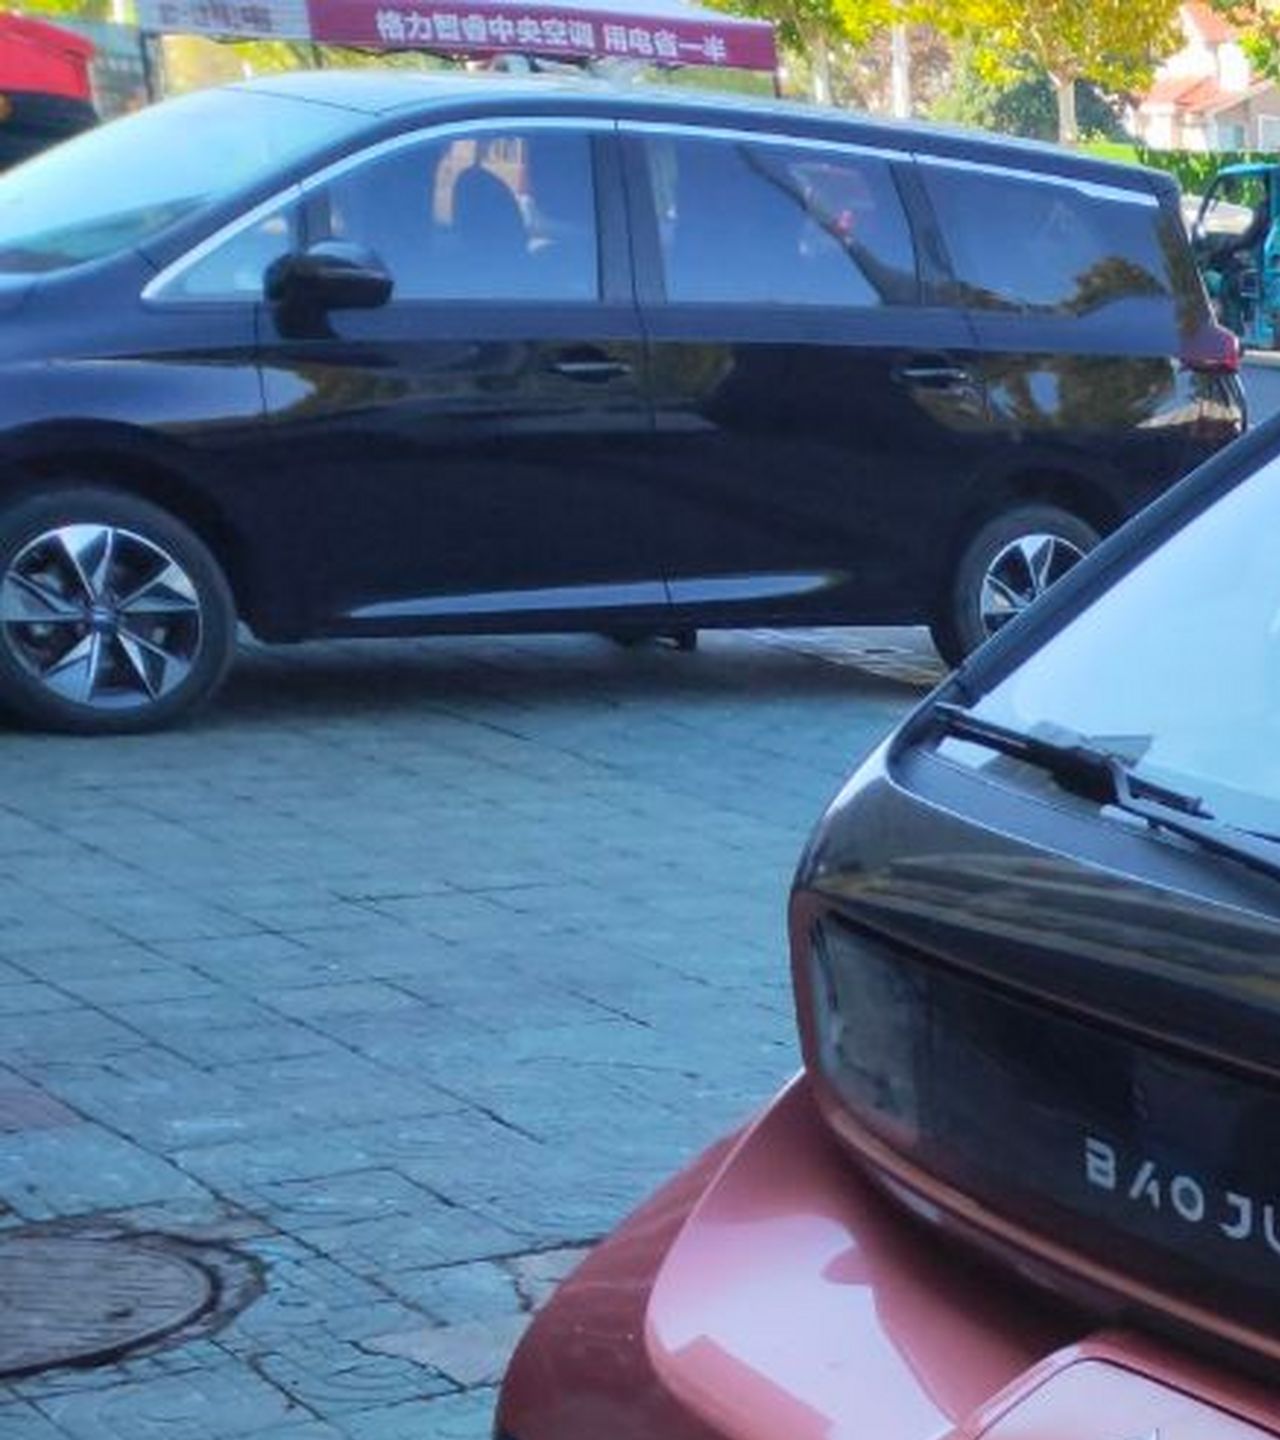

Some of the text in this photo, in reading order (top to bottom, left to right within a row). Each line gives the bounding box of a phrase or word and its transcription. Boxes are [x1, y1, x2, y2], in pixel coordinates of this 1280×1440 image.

[602, 24, 726, 63] 用电省一半
